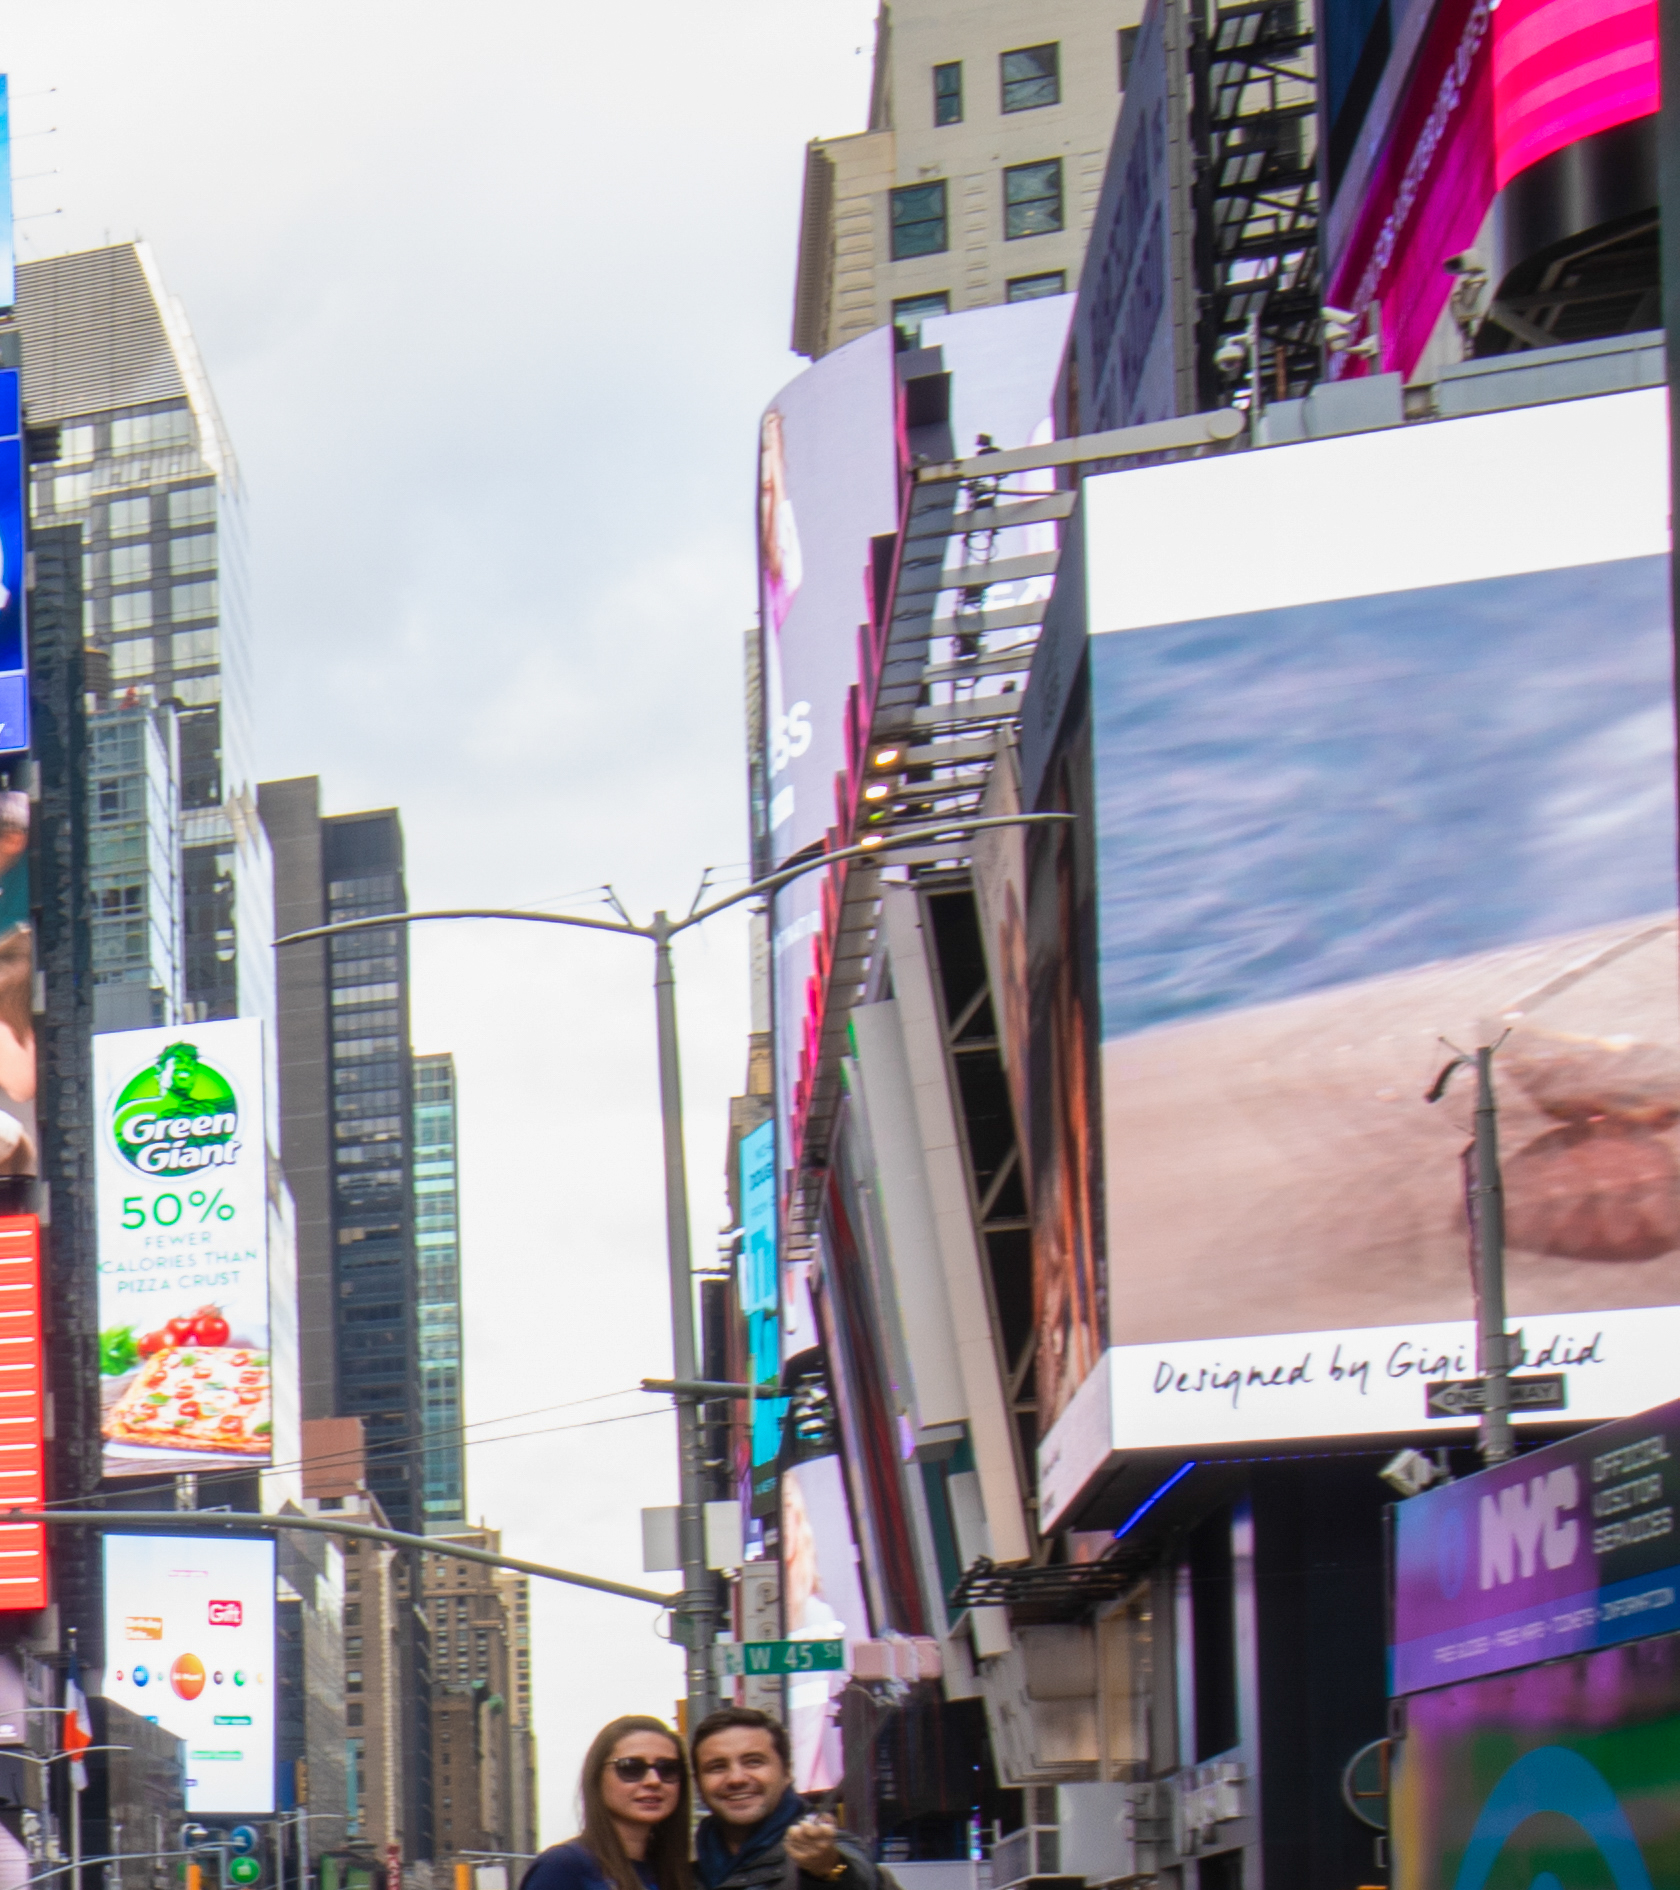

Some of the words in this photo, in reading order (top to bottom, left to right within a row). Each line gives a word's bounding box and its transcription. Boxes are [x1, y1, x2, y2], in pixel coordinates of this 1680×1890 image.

[121, 1111, 237, 1145] Green
[136, 1140, 240, 1173] Giant
[121, 1187, 235, 1230] 50%
[144, 1230, 212, 1249] FEWER
[101, 1254, 198, 1275] CALORIES
[205, 1249, 258, 1266] THAN
[117, 1279, 171, 1294] PIZZA
[178, 1270, 241, 1289] CRUST
[1153, 1352, 1313, 1409] Designed
[1329, 1344, 1370, 1395] by
[1387, 1341, 1468, 1382] Gigi
[1478, 1464, 1581, 1591] NYC
[748, 1646, 772, 1670] W
[783, 1644, 814, 1669] 45
